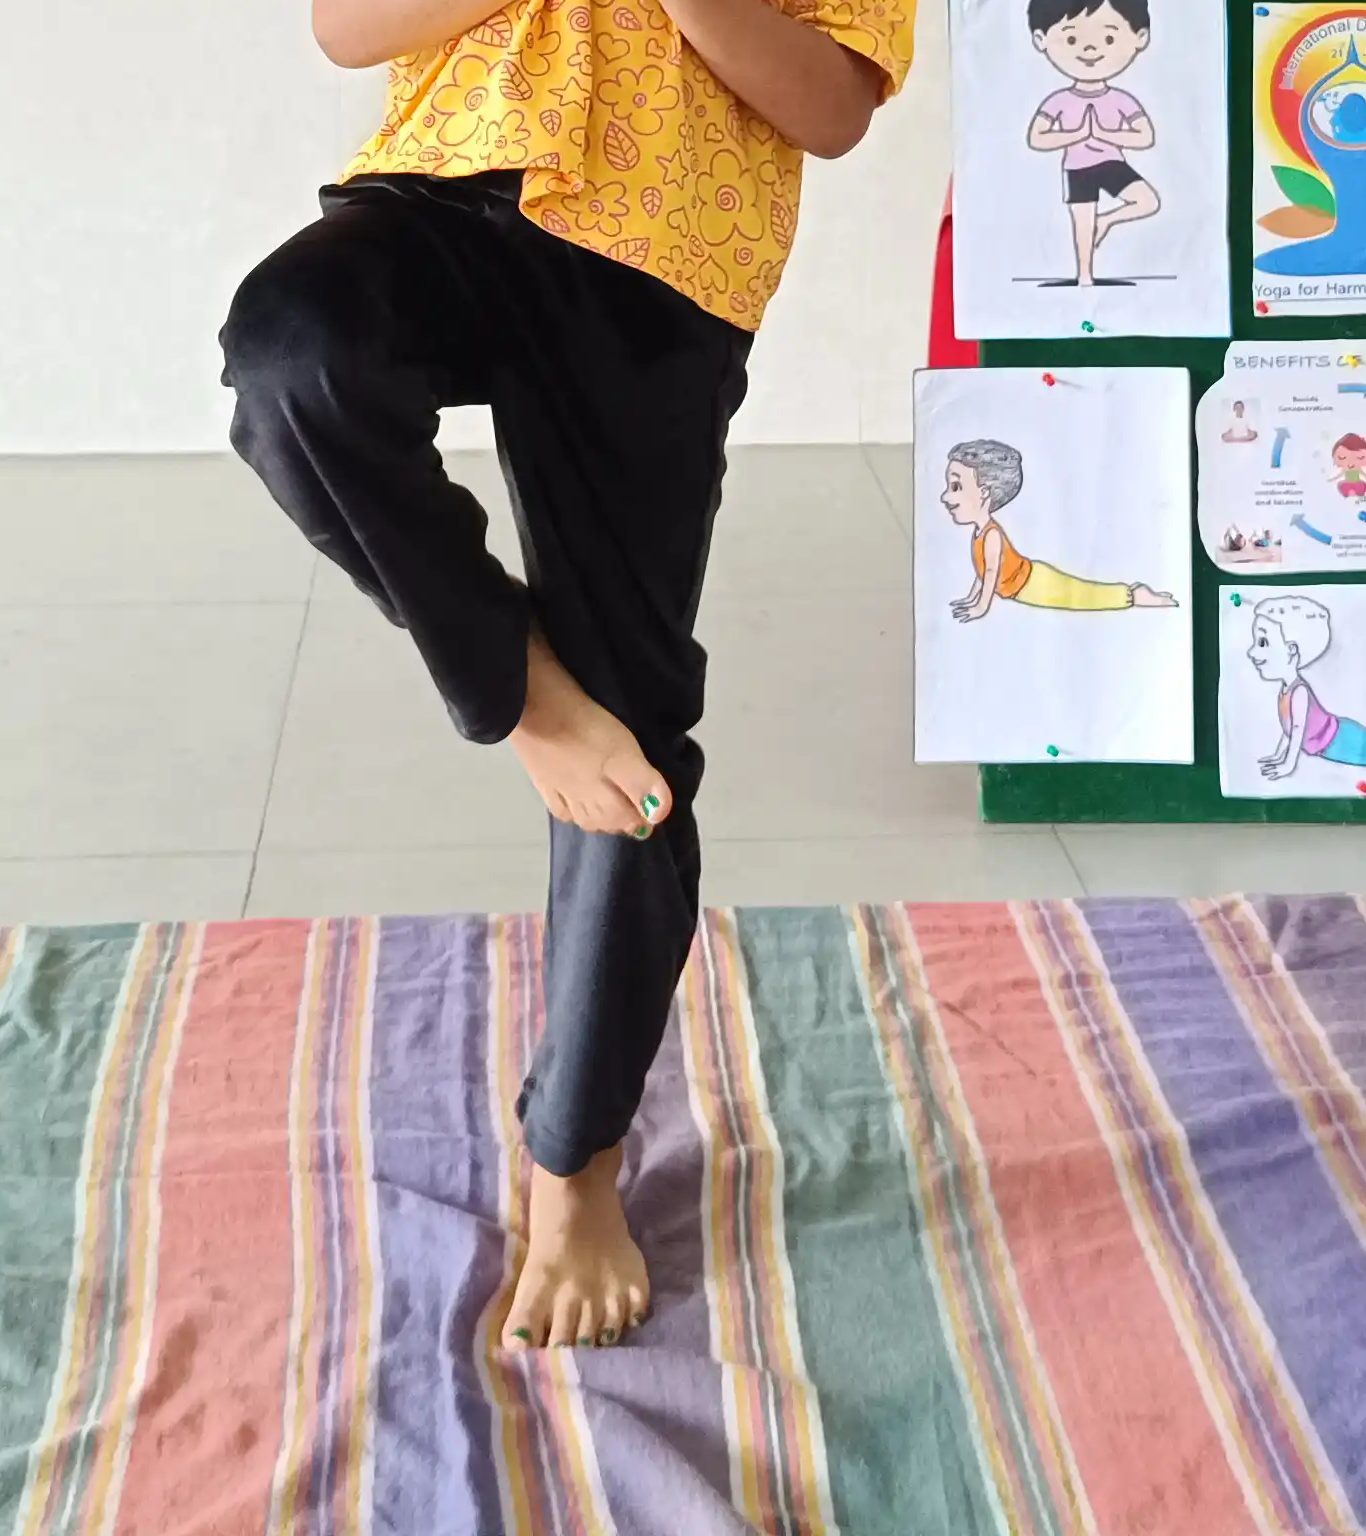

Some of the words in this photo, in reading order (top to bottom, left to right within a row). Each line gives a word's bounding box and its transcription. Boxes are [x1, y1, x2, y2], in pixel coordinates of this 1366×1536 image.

[1280, 19, 1351, 89] ternational
[1255, 283, 1291, 299] Yoga
[1298, 282, 1319, 296] for
[1233, 355, 1331, 369] BENEFITS
